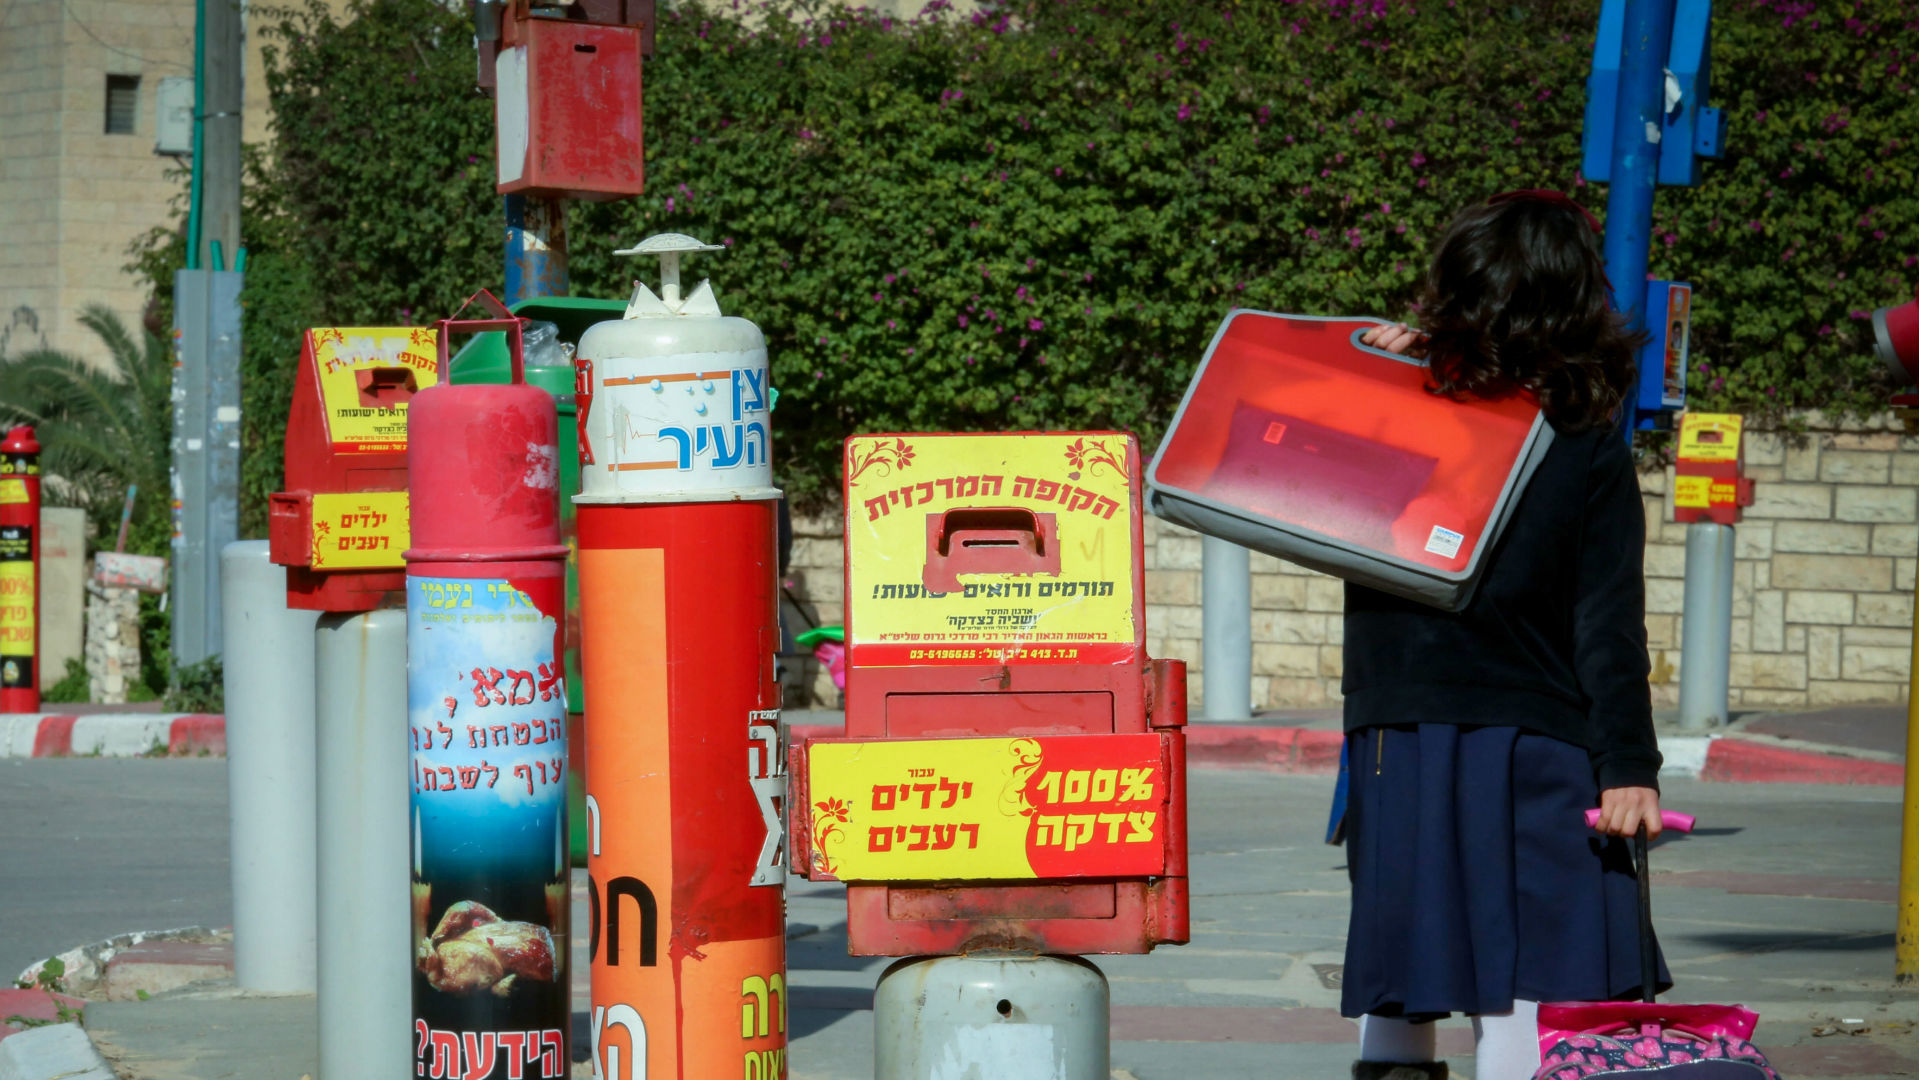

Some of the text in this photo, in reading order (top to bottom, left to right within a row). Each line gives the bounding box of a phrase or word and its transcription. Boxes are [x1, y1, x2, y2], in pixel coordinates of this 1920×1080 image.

[396, 351, 439, 374] הקופ
[730, 367, 769, 422] צן
[658, 421, 767, 470] העיר
[863, 474, 1121, 522] הקופה המרכזית
[340, 511, 388, 528] ילדים
[338, 536, 389, 551] רעבים
[421, 582, 473, 610] נעמי
[872, 581, 1114, 600] תורמים ורואים ועות!
[946, 615, 994, 630] בצדקה'
[1011, 608, 1033, 616] ארגון
[879, 631, 1108, 642] בראשות הגאון האדיר רבי מרדכי גרוס שליט"א
[411, 718, 561, 751] הבטחת לנו
[414, 758, 563, 795] עוף לשבת!
[907, 767, 935, 778] עבור
[1036, 766, 1155, 805] 100%
[870, 776, 973, 811] ילדים
[867, 823, 980, 853] רעבים
[1035, 811, 1157, 852] צדקה
[415, 1018, 564, 1080] הידעת?
